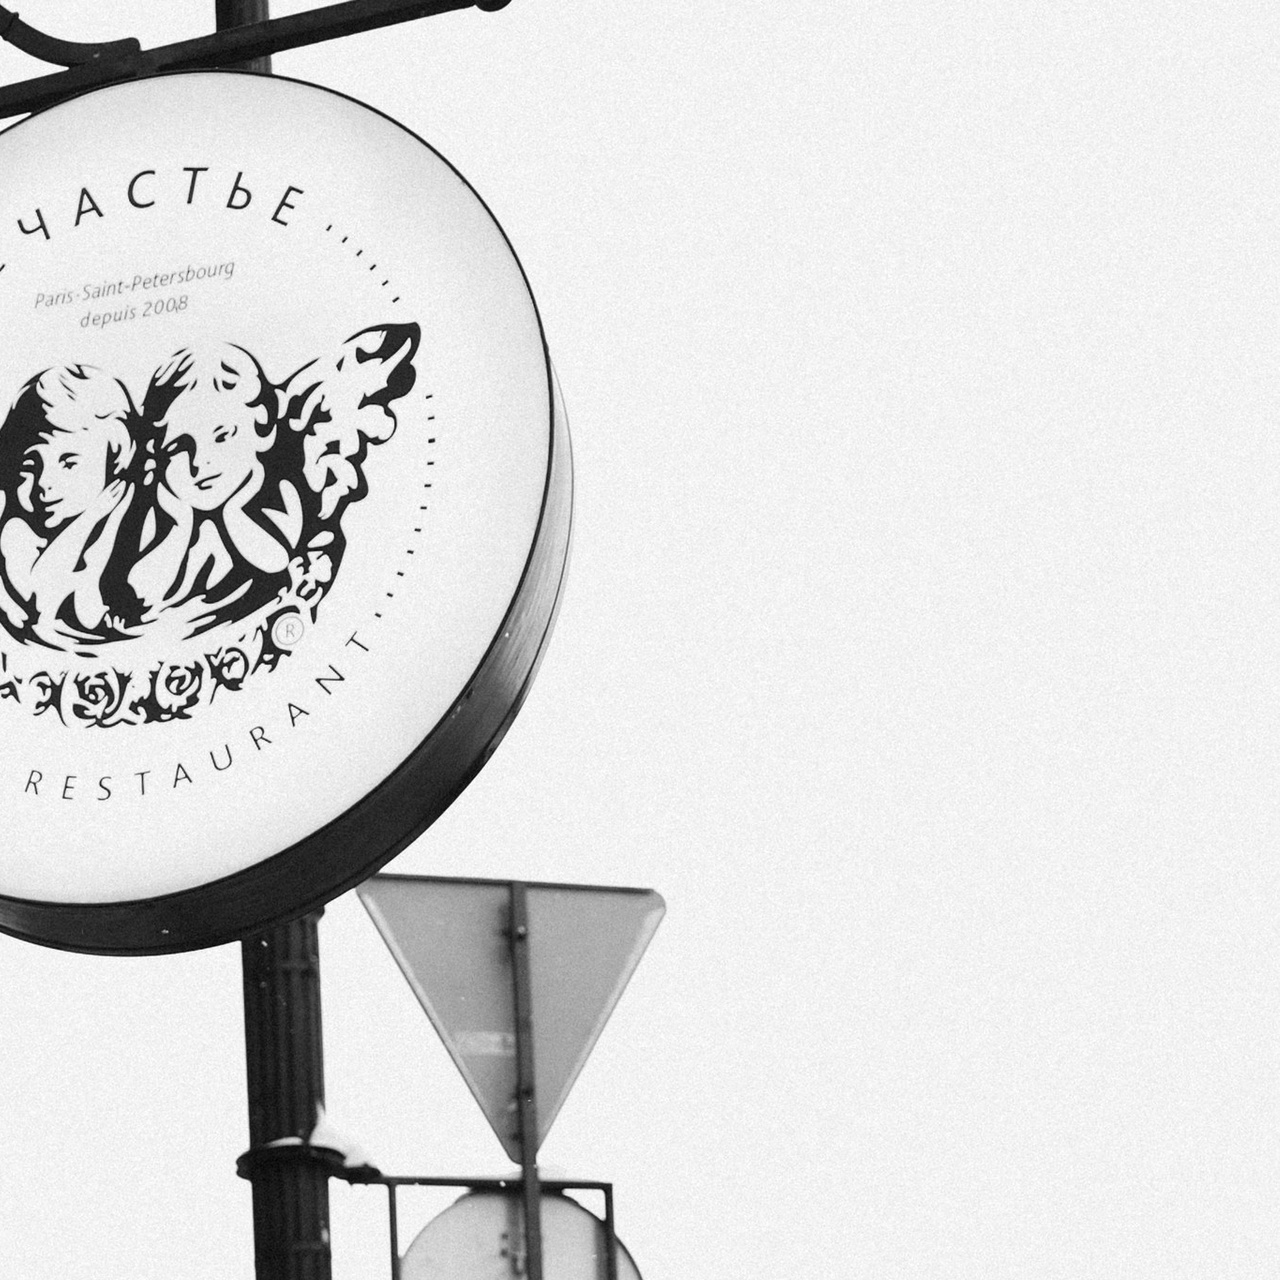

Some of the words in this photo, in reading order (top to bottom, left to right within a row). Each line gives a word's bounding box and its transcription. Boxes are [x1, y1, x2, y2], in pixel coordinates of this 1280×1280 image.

[80, 306, 136, 328] depuis
[142, 295, 189, 317] 2008
[23, 631, 370, 801] RESTAURANT
